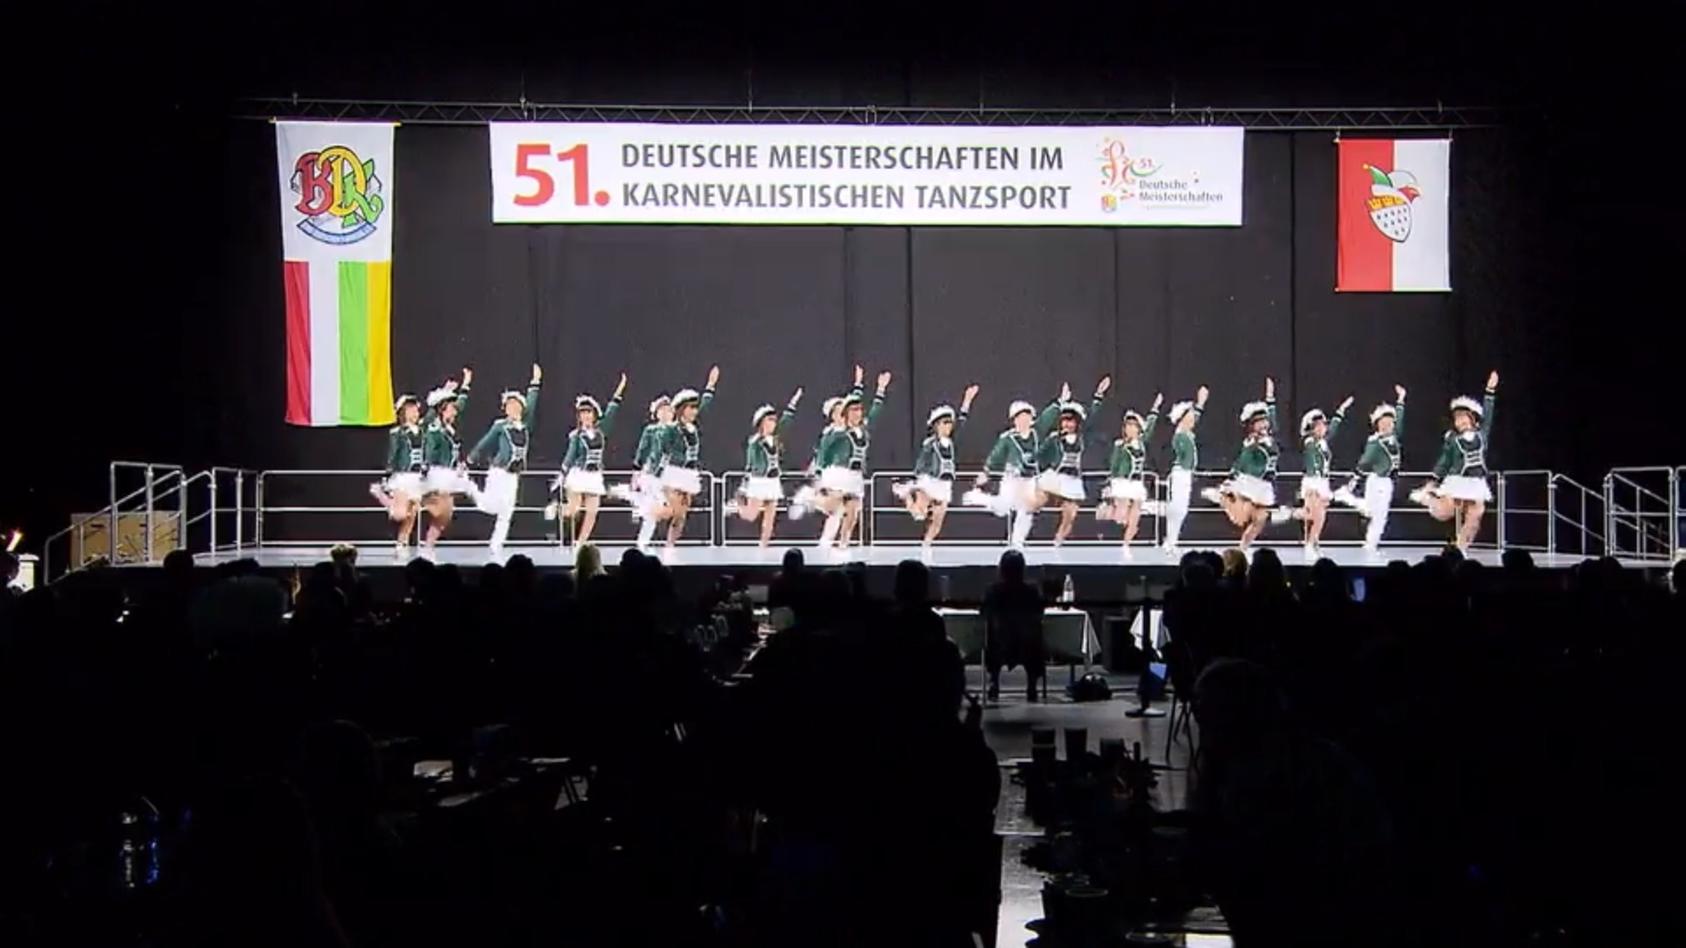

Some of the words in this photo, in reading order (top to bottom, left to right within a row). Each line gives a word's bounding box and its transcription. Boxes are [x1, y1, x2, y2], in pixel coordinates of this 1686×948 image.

[622, 143, 758, 168] DEUTSCHE
[768, 145, 1020, 170] MEISTERSCHAFTEN
[1030, 146, 1064, 170] IM
[513, 143, 611, 207] 51.
[1139, 179, 1188, 189] Deutsche
[622, 183, 905, 208] KARNEVALISTISCHEN
[915, 185, 1071, 210] TANZSPORT
[1138, 191, 1223, 202] Meisterschaften
